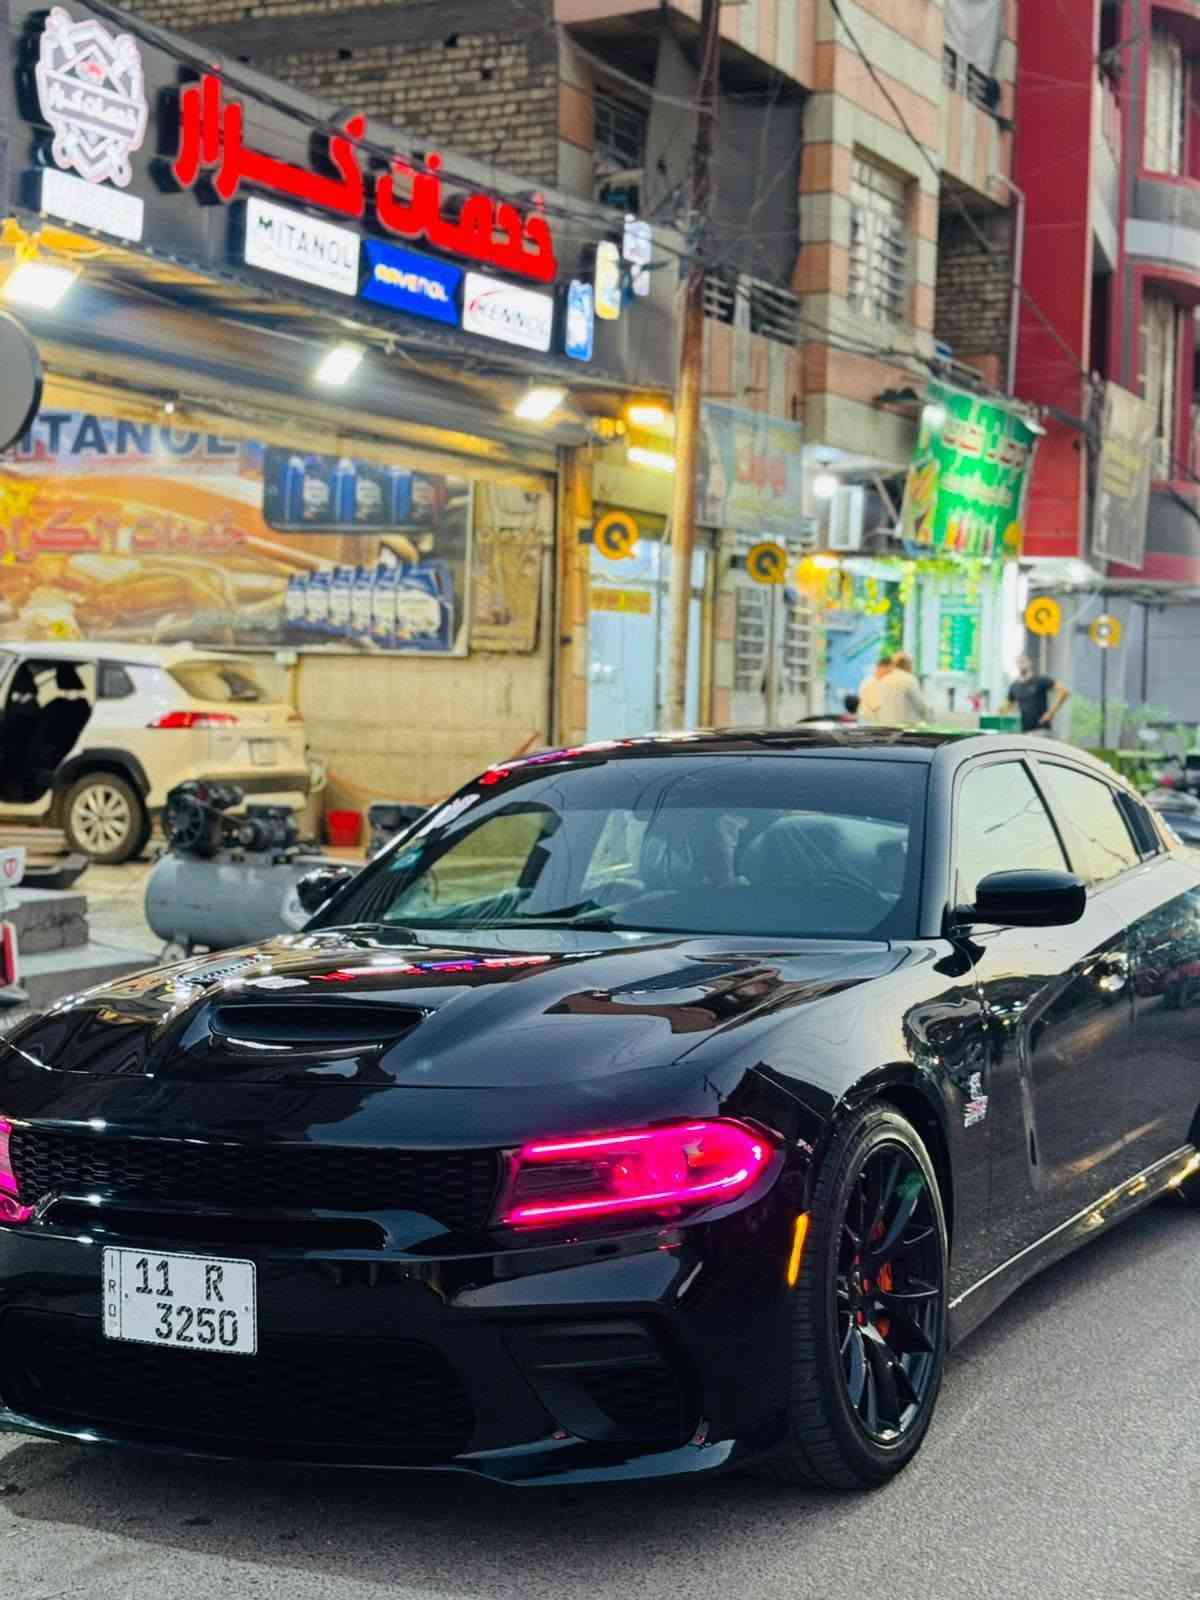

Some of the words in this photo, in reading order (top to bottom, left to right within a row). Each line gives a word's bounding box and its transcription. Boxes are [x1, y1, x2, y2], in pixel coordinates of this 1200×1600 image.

[256, 215, 352, 270] MITANOL
[20, 412, 238, 456] ITANOL
[135, 1256, 174, 1297] 11
[204, 1264, 224, 1302] R
[154, 1301, 239, 1347] 3250
